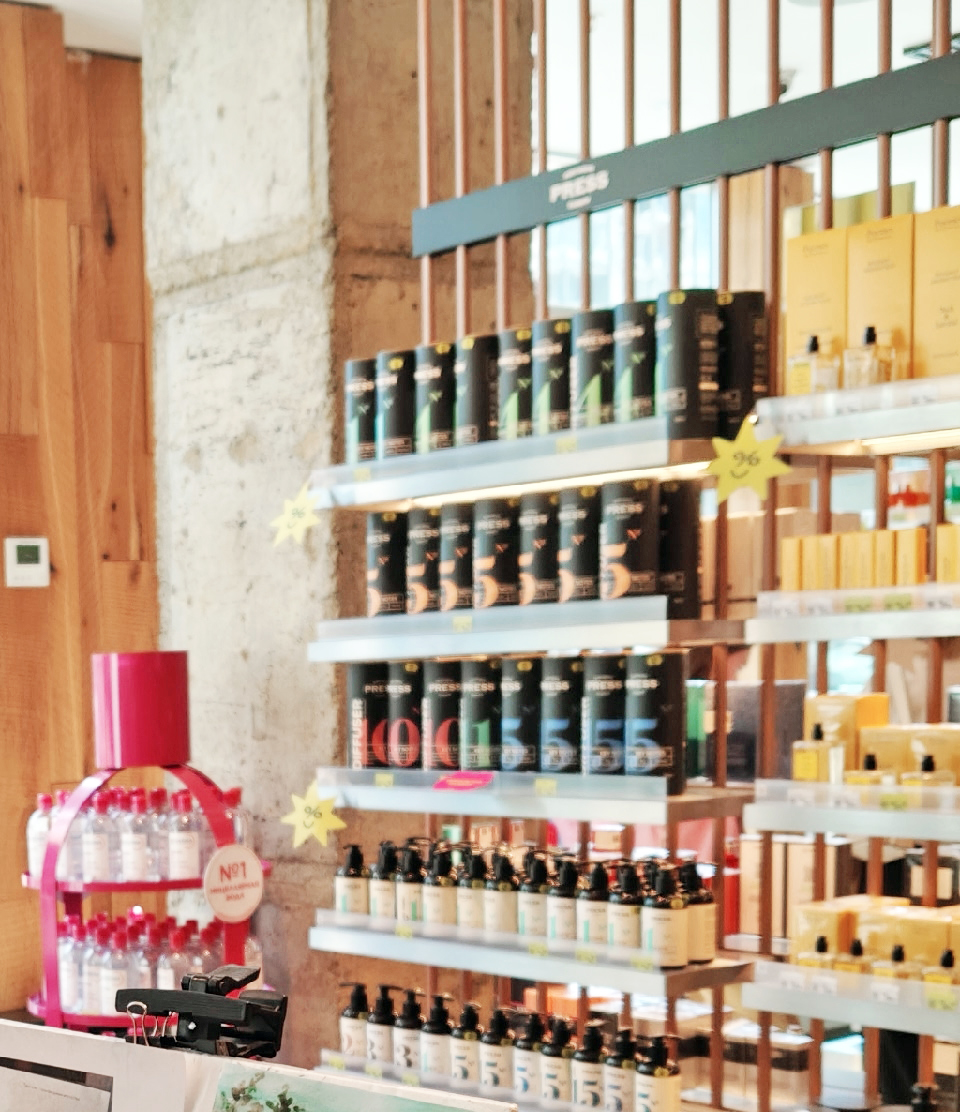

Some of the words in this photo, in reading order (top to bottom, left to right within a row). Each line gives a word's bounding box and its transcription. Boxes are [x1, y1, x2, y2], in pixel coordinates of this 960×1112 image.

[549, 170, 609, 203] PRESS
[364, 684, 388, 694] PRE
[501, 681, 522, 691] ESS
